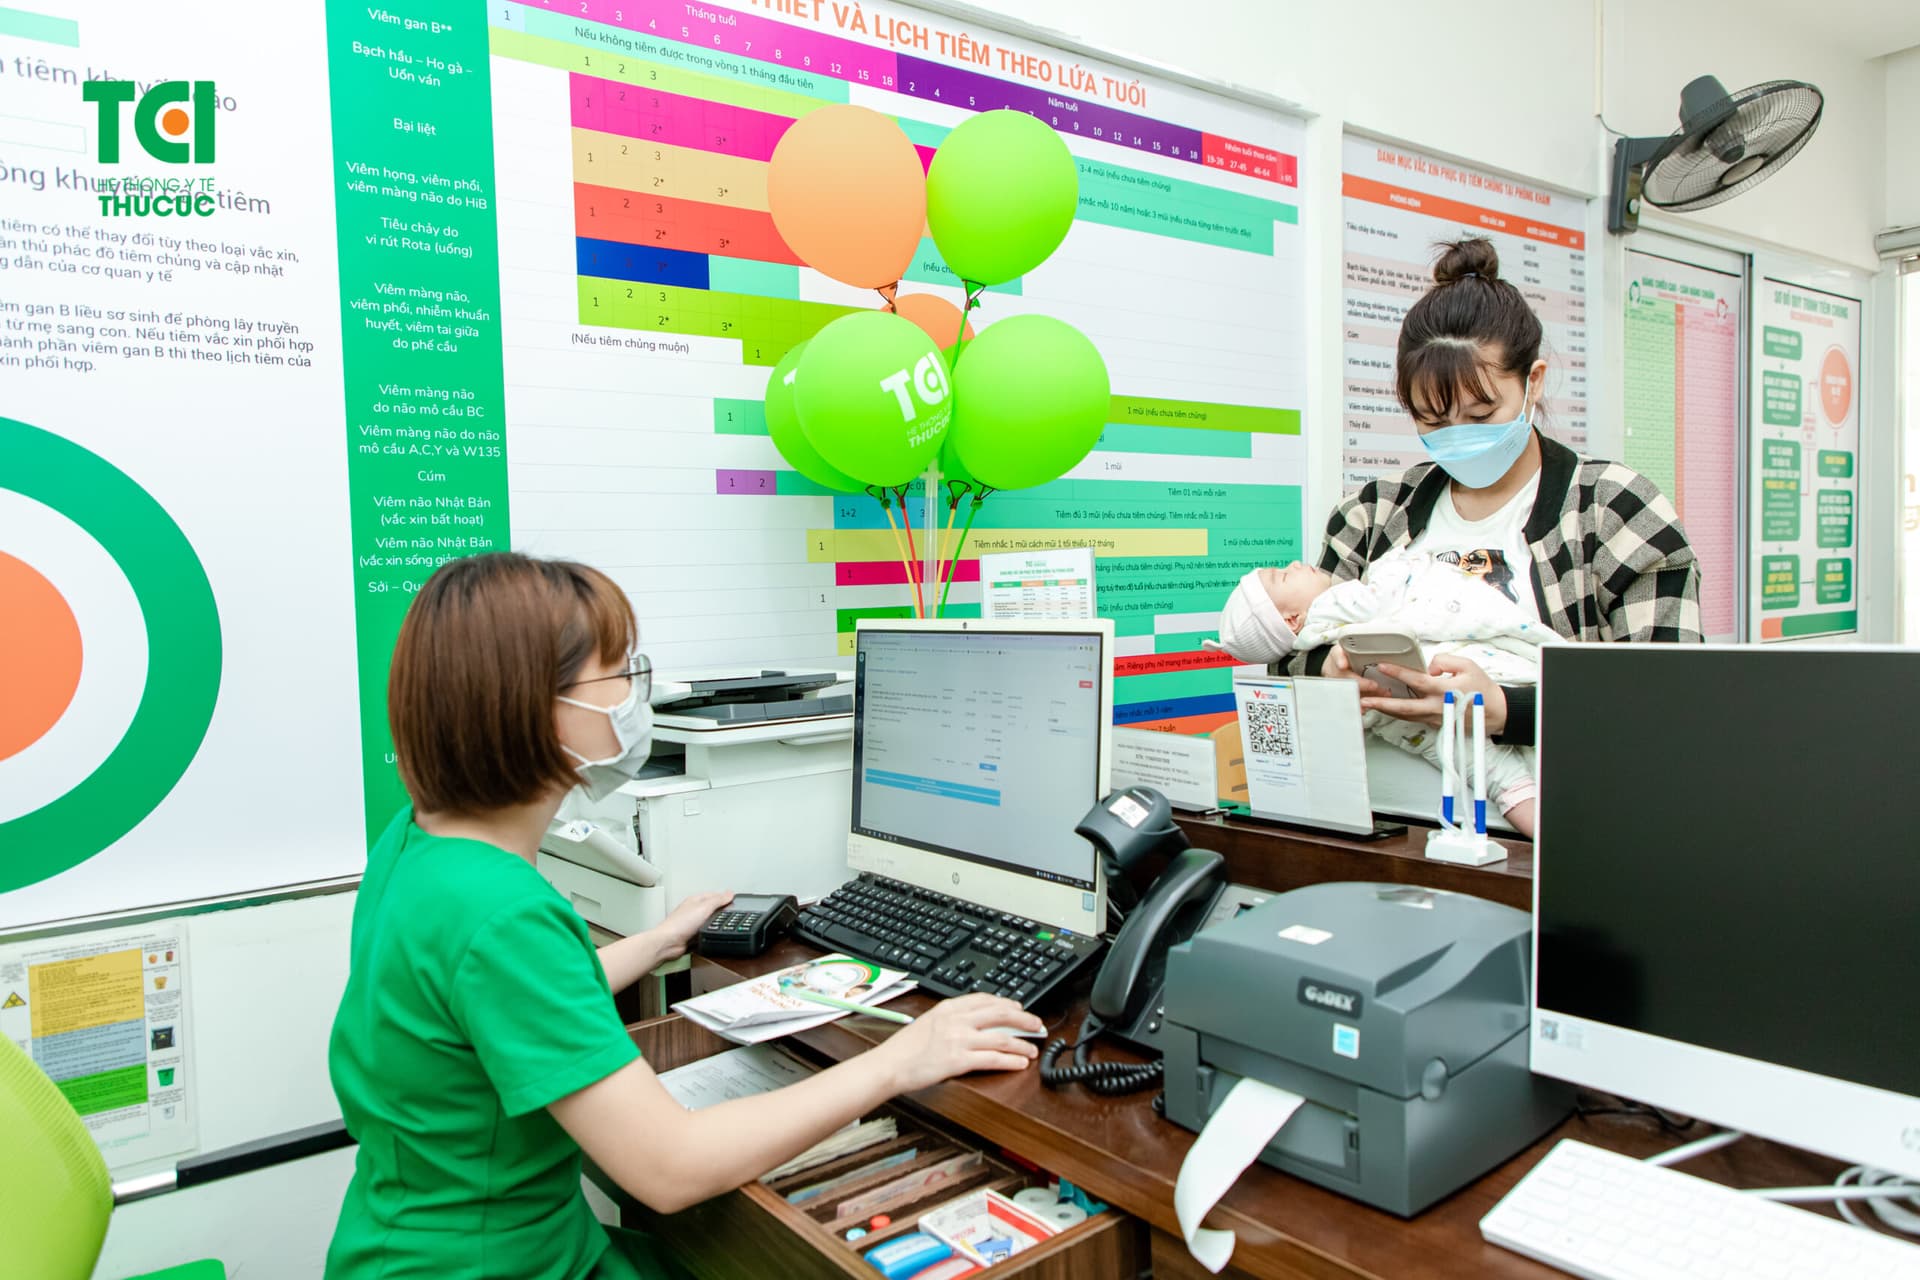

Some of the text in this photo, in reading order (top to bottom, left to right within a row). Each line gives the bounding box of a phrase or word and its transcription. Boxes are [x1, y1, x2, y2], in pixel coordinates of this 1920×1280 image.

[368, 8, 400, 25] Viêm
[404, 18, 427, 30] gan
[685, 4, 737, 26] Tháng tuổi
[581, 2, 893, 86] 2 3 4 5 6 7 8 9 12 15 18
[352, 42, 462, 74] Bạch hầu Ho gà
[575, 27, 814, 89] Nếu không tiêm được trong vòng 1 tháng đầu tiên
[832, 2, 867, 35] VÀ
[874, 14, 929, 51] LỊCH
[935, 31, 990, 66] TIÊM
[997, 47, 1052, 82] THEO
[1058, 64, 1098, 95] LỨA
[1102, 76, 1147, 109] TUỔI
[14, 57, 78, 86] tiêm
[389, 66, 440, 87] Uốn ván
[1048, 97, 1079, 112] Năm tuổi
[394, 118, 436, 136] Bại liệt
[346, 161, 482, 193] Viêm họng, viêm phổi,
[217, 189, 271, 215] tiêm
[347, 181, 487, 209] viêm màng não do HiB
[380, 217, 458, 237] Tiêu chảy do
[2, 219, 299, 263] tiêm có thể thay đổi tùy theo loại vắc xin,
[366, 235, 472, 258] vi rút Rota (uống)
[14, 255, 172, 283] dẫn của cơ quan y tế
[23, 239, 283, 278] thủ phác đồ tiêm chủng và cập nhật
[374, 283, 470, 303] Viêm màng não,
[350, 299, 489, 321] viêm phổi, nhiễm khuẩn
[366, 318, 479, 338] huyết, viêm tai giữa
[393, 338, 457, 353] do phế cầu
[571, 332, 690, 355] (Nếu tiêm chủng muộn)
[360, 425, 500, 441] Viêm màng não do não
[360, 441, 500, 458] mô cầu A,C,Y và W135
[418, 469, 446, 481] Cúm
[373, 495, 491, 510] Viêm não Nhật Bản
[840, 508, 856, 518] 1+2
[381, 512, 483, 527] (vắc xin bất hoạt)
